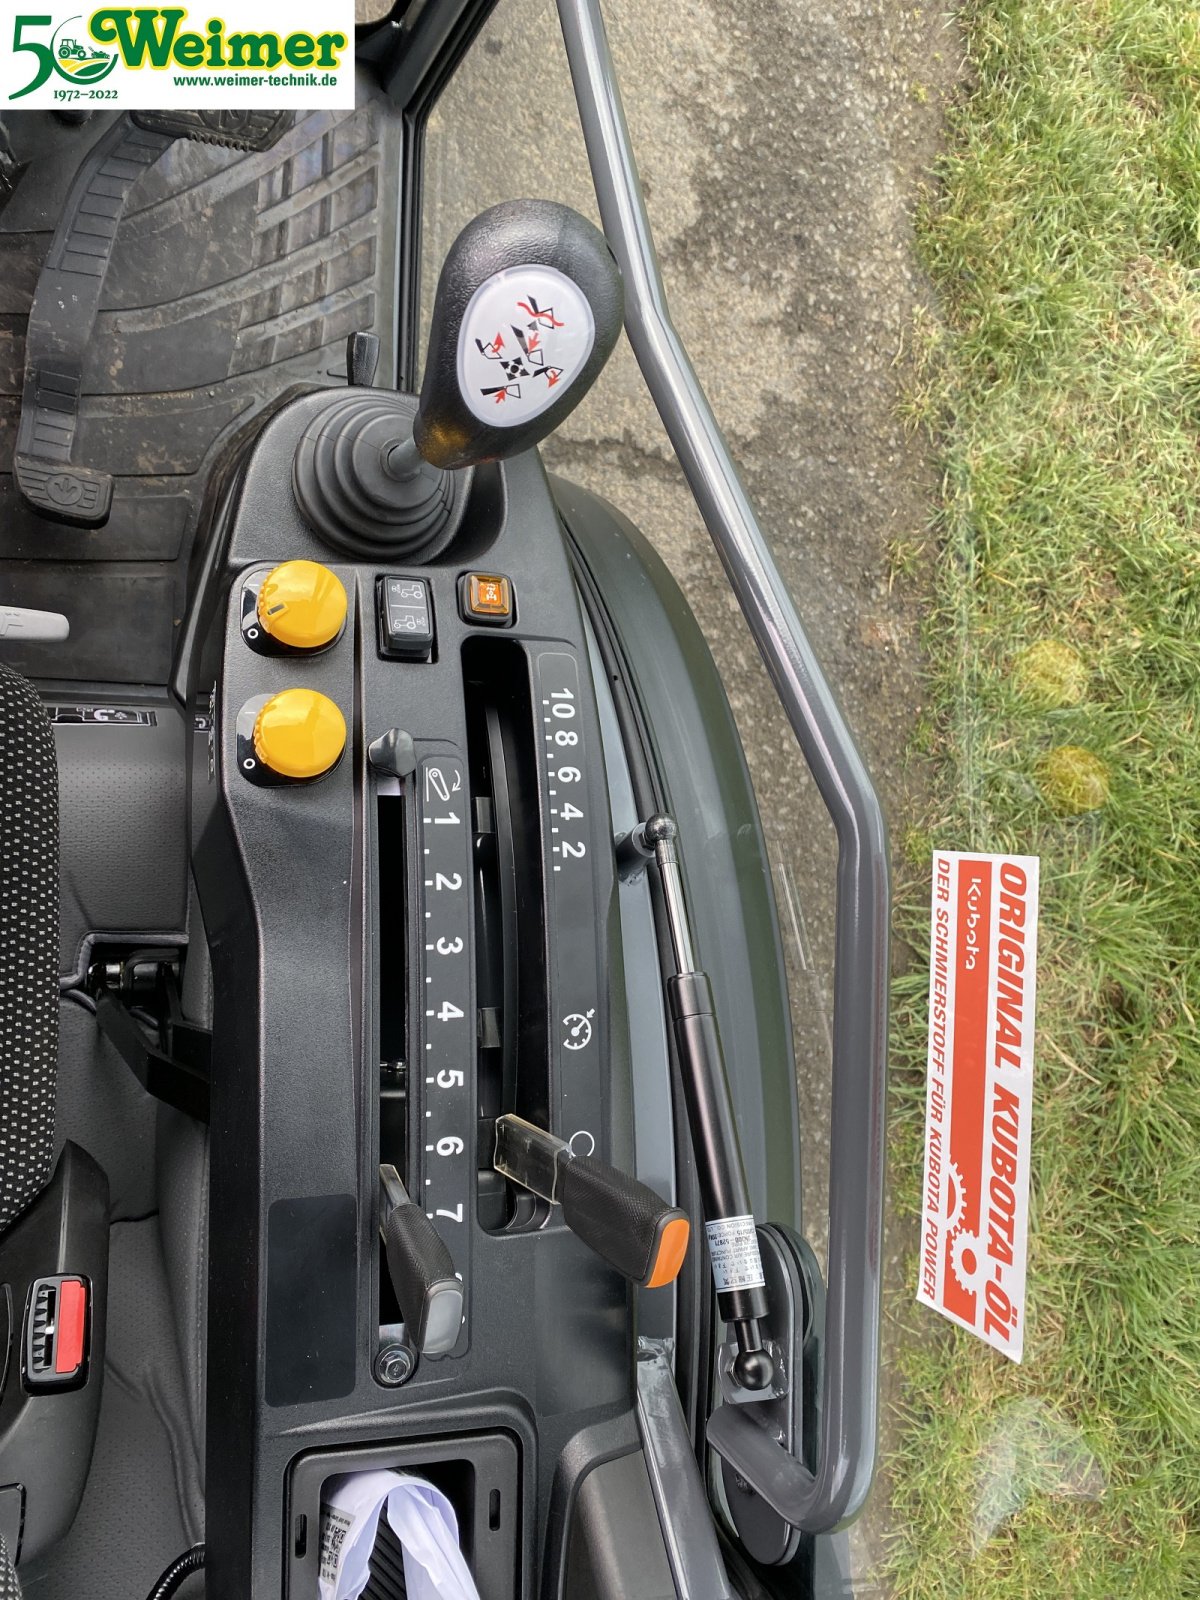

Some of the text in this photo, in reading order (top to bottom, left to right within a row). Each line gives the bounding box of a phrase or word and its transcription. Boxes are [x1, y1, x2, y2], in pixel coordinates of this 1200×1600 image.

[551, 688, 586, 858] 10 8 6 4 2
[965, 878, 982, 970] Kubota
[434, 812, 464, 1223] 1 2 3 4 5 6 7
[922, 858, 950, 1300] DER SCHMIERSTOFF FÜR KUBOTA POWER
[983, 862, 1027, 1342] ORIGINAL KUBOTA-ÖL
